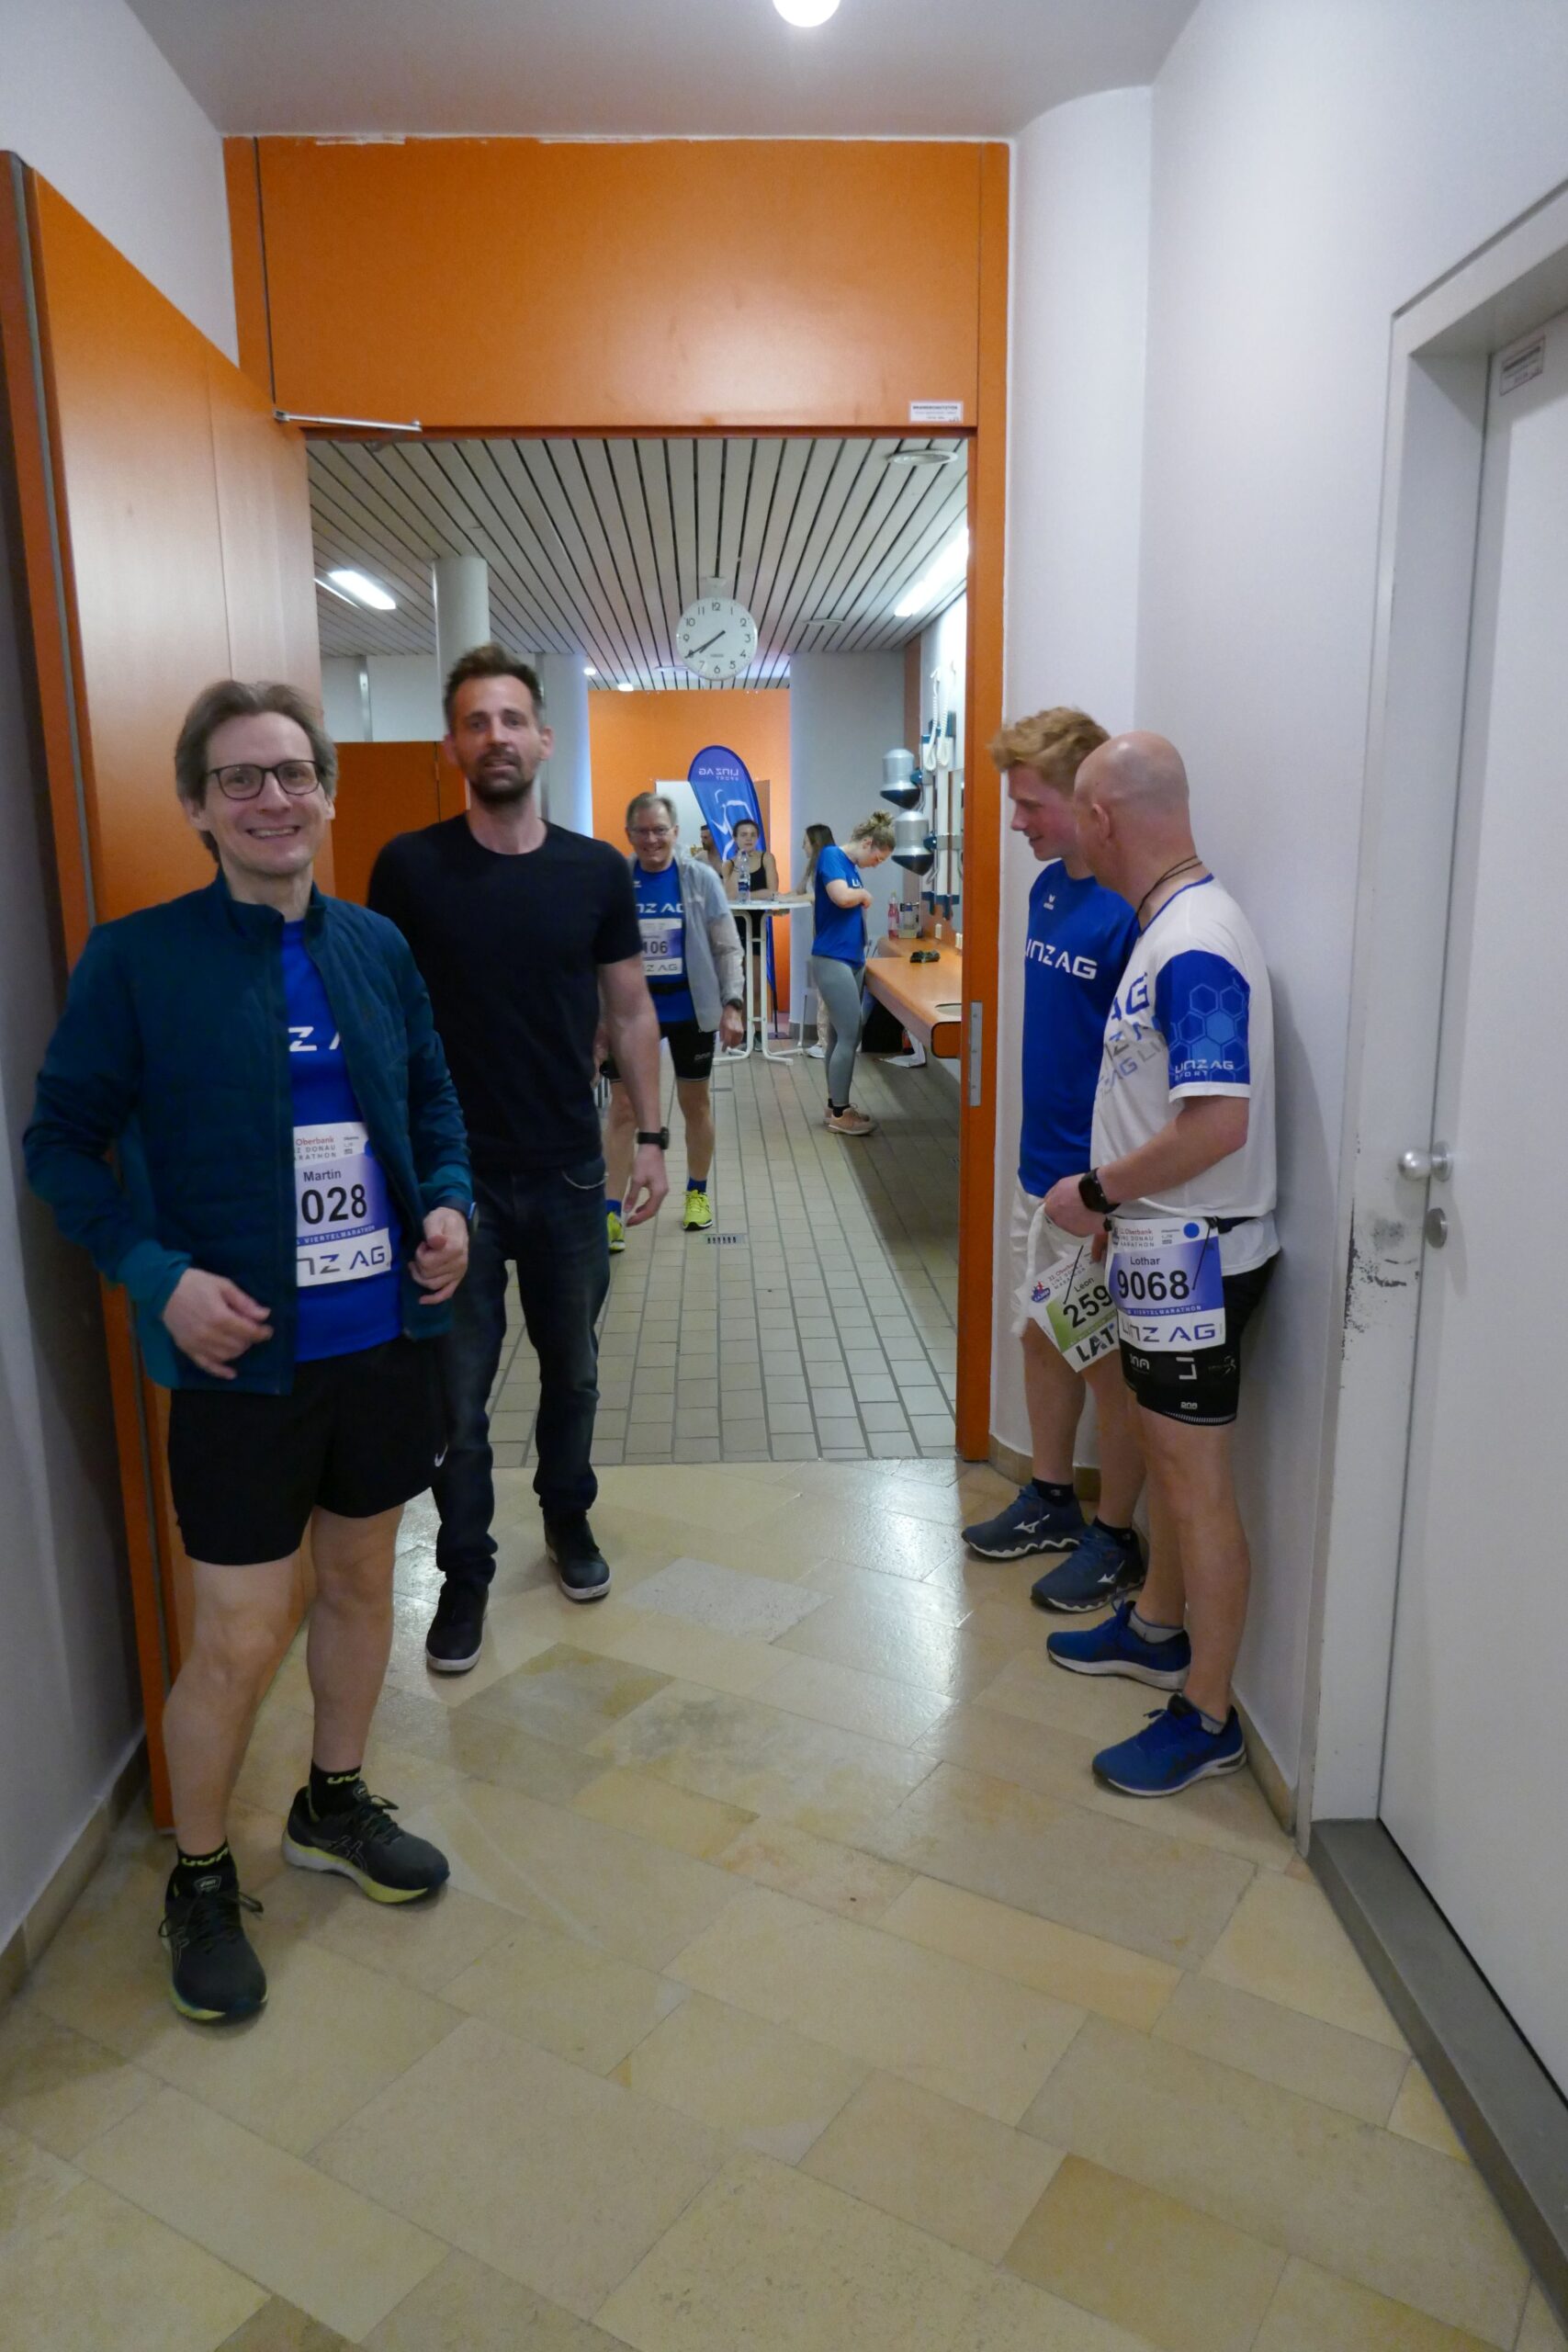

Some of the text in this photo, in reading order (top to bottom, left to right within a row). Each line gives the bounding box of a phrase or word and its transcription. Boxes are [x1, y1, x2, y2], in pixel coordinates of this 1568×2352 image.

[698, 606, 705, 616] 11
[711, 602, 721, 611] 12
[685, 617, 695, 627] 10
[739, 617, 747, 627] 2
[682, 633, 690, 642] 9
[744, 633, 751, 643] 3
[739, 649, 747, 658] 4
[699, 661, 705, 670] 7
[714, 665, 721, 674] 6
[729, 661, 737, 670] 5
[636, 903, 657, 913] NZ
[1026, 938, 1098, 979] INZ AG
[1211, 1060, 1235, 1069] AG
[296, 1136, 334, 1146] Oberbank
[306, 1145, 335, 1153] DONAU
[294, 1152, 336, 1160] RATHON
[303, 1169, 342, 1182] Martin
[304, 1225, 376, 1244] VIERTELMARATHON
[297, 1246, 385, 1275] NZ AG
[1130, 1256, 1161, 1265] Lothar
[1074, 1277, 1095, 1293] Leon
[1117, 1270, 1190, 1301] 9068
[1063, 1284, 1112, 1329] 259
[1168, 1323, 1215, 1342] AG
